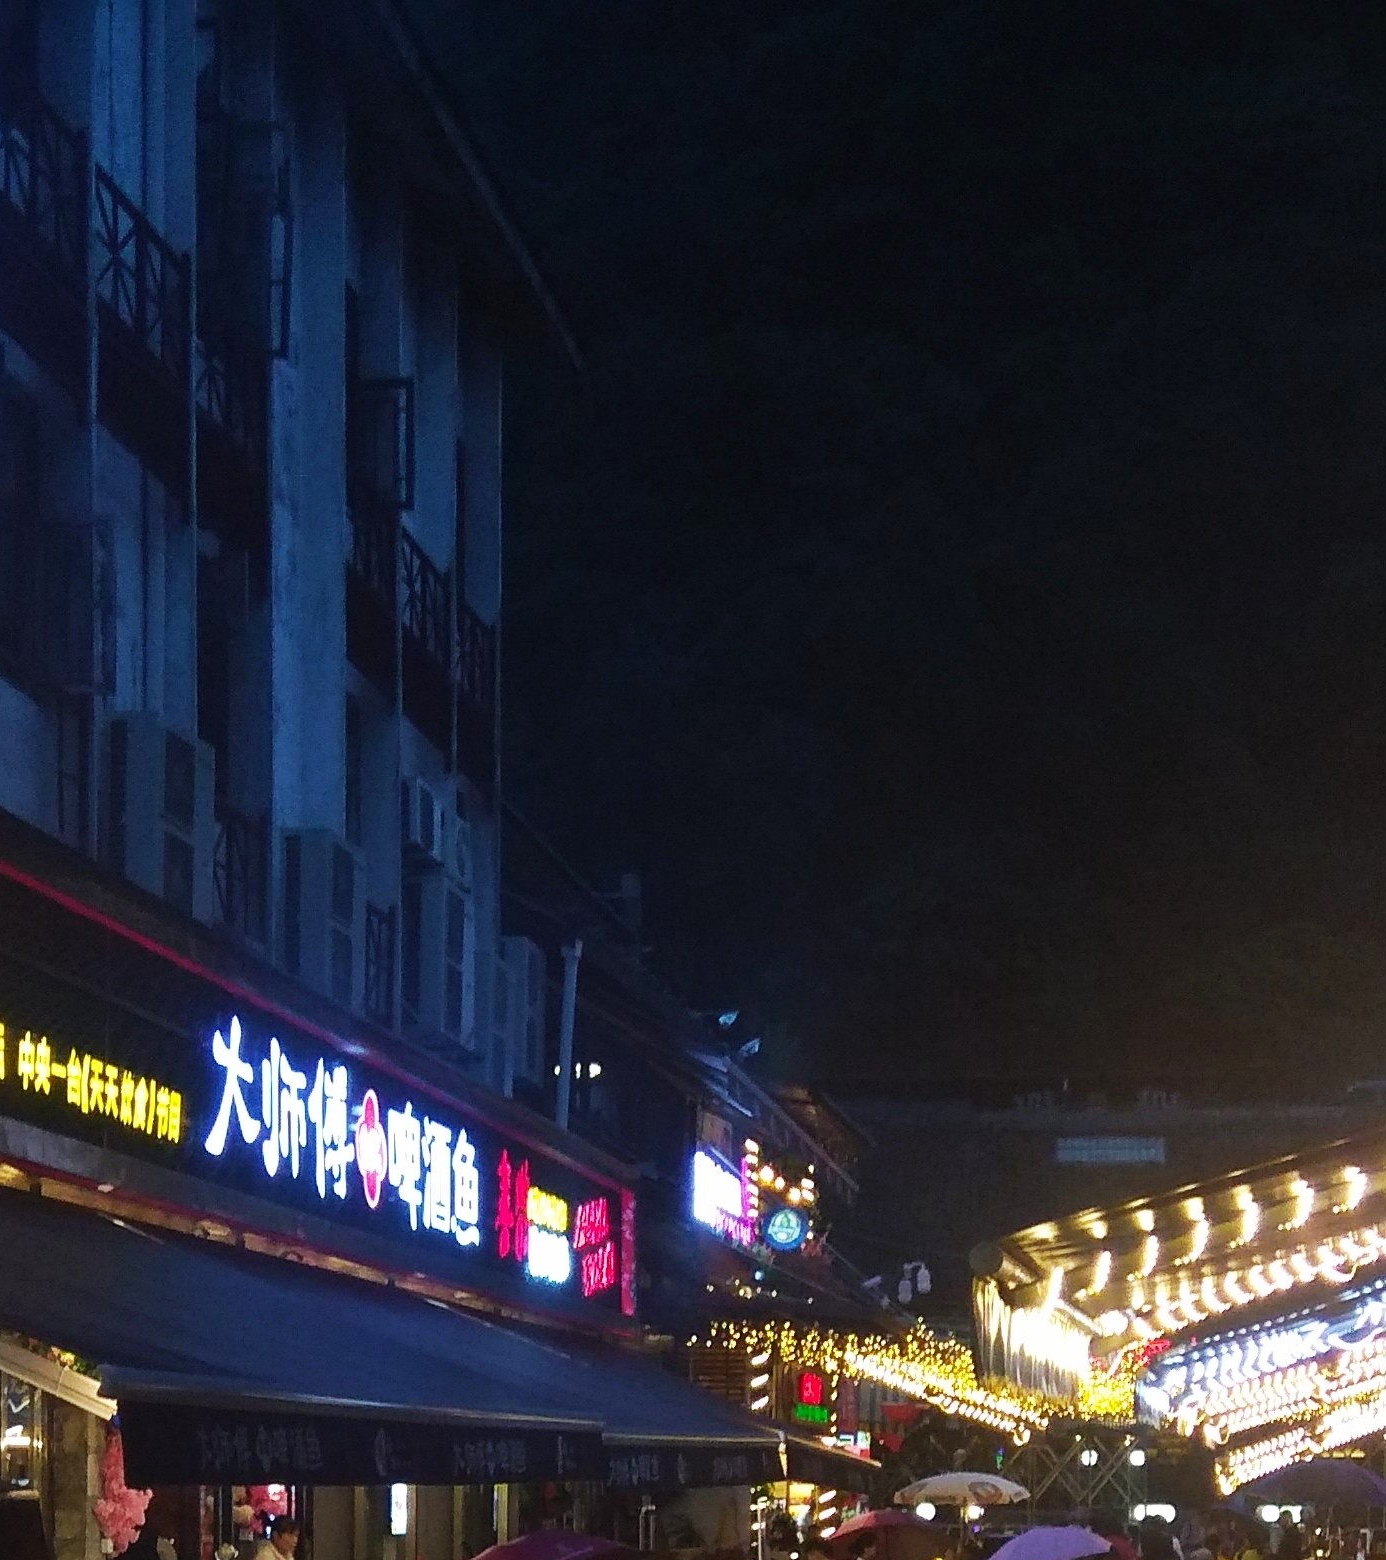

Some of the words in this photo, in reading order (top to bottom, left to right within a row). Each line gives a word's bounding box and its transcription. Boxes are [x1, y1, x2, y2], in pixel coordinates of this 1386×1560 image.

[204, 1014, 356, 1200] 大师傅
[387, 1100, 481, 1248] 啤酒鱼
